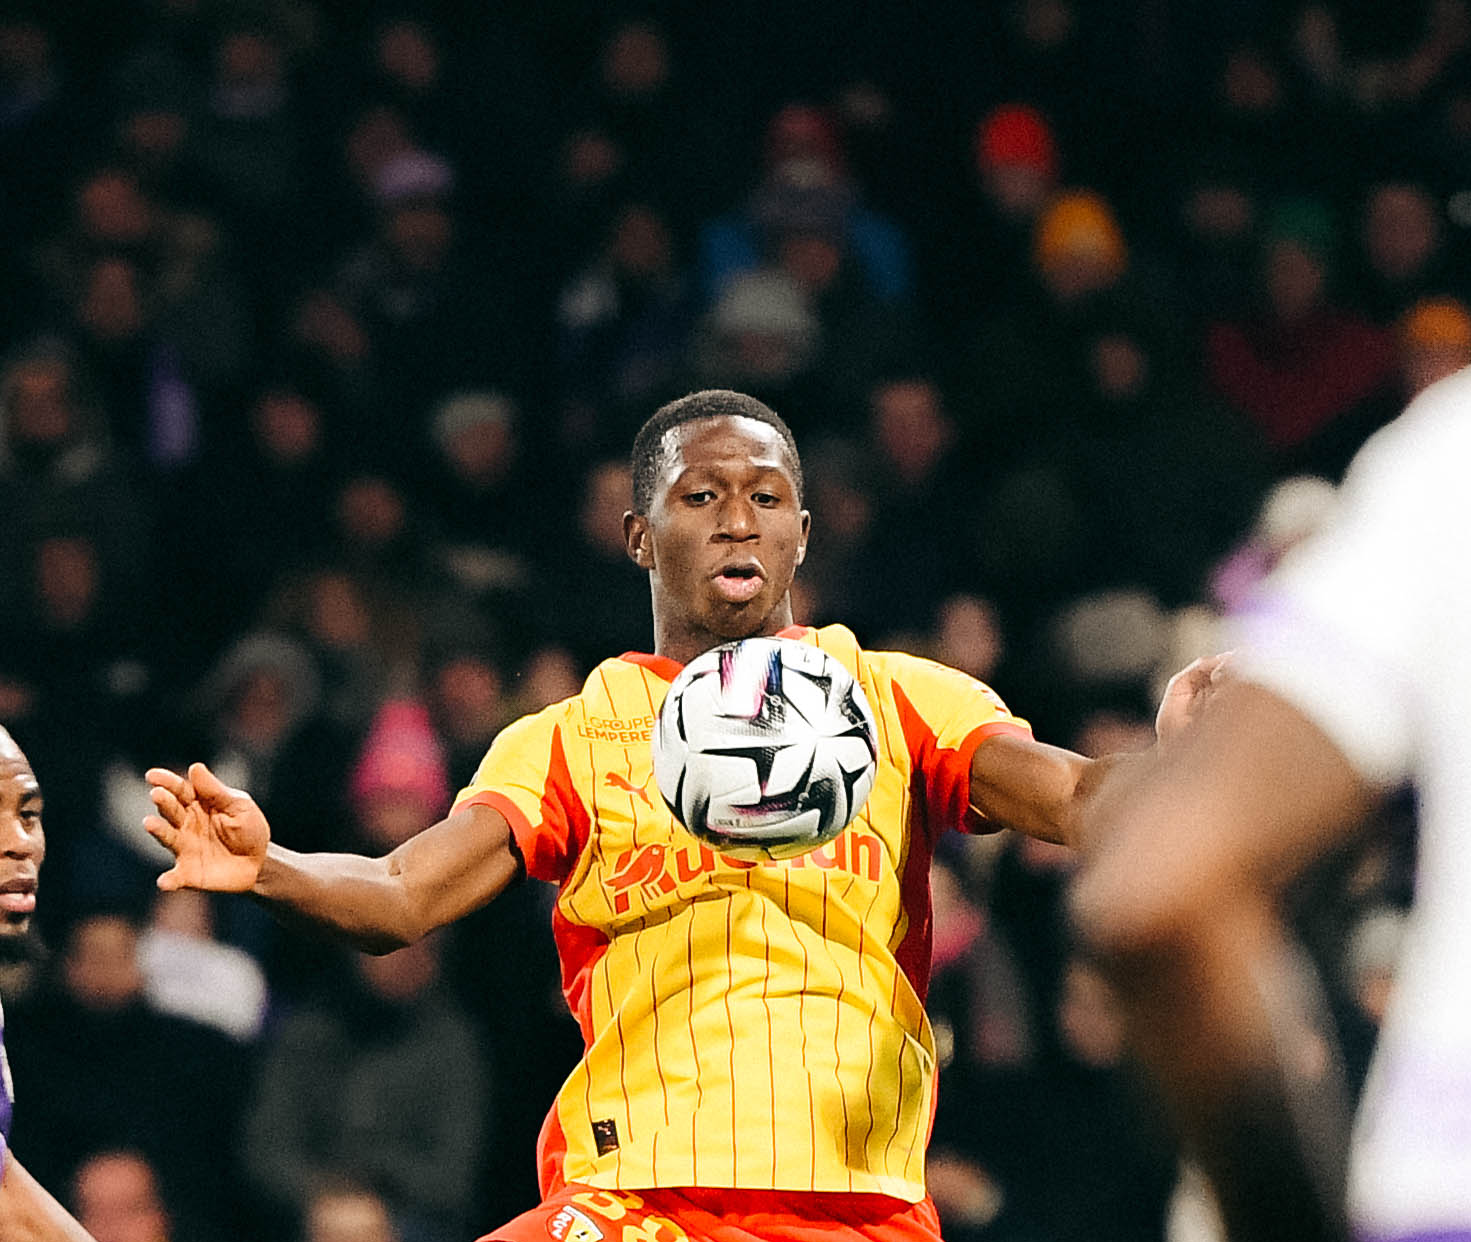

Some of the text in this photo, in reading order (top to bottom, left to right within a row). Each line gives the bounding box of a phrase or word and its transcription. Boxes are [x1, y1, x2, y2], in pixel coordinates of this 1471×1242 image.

[589, 715, 654, 730] GROUPE
[576, 724, 653, 743] LEMPERE
[603, 830, 882, 914] Auan
